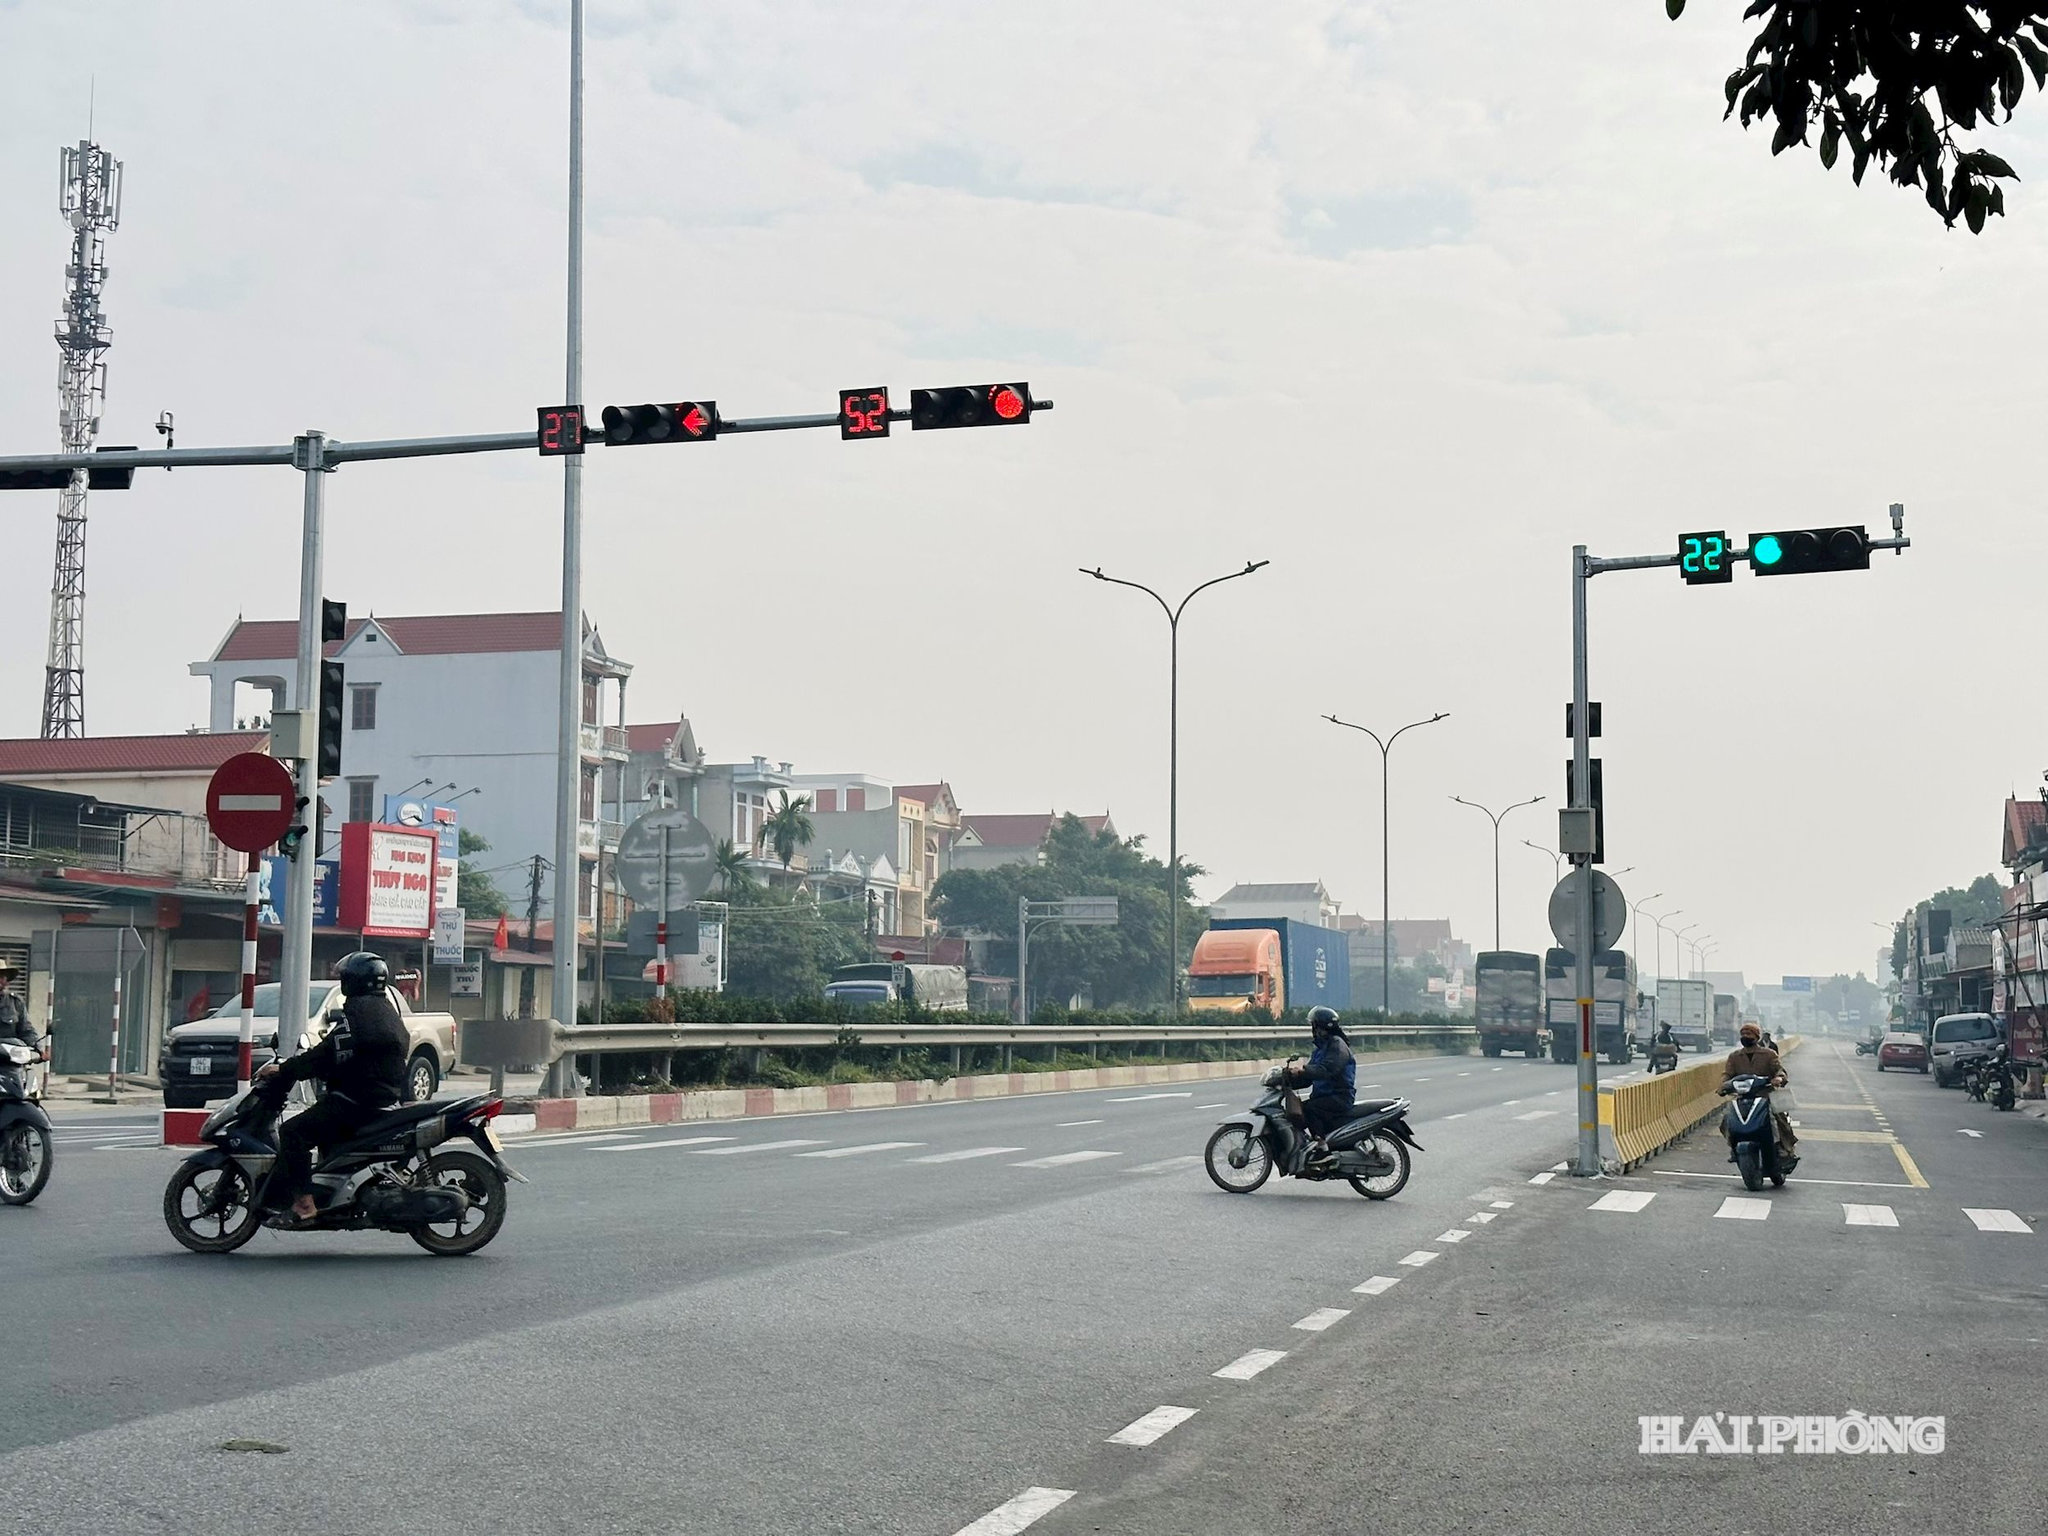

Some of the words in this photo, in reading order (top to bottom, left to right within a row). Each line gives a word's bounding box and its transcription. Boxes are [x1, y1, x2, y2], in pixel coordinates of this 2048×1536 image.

[844, 394, 885, 432] 52
[544, 412, 581, 449] 27
[1683, 537, 1722, 572] 22
[403, 873, 427, 891] NGA
[441, 920, 457, 930] THÚ
[446, 934, 451, 942] Y
[435, 944, 462, 955] THUỐC
